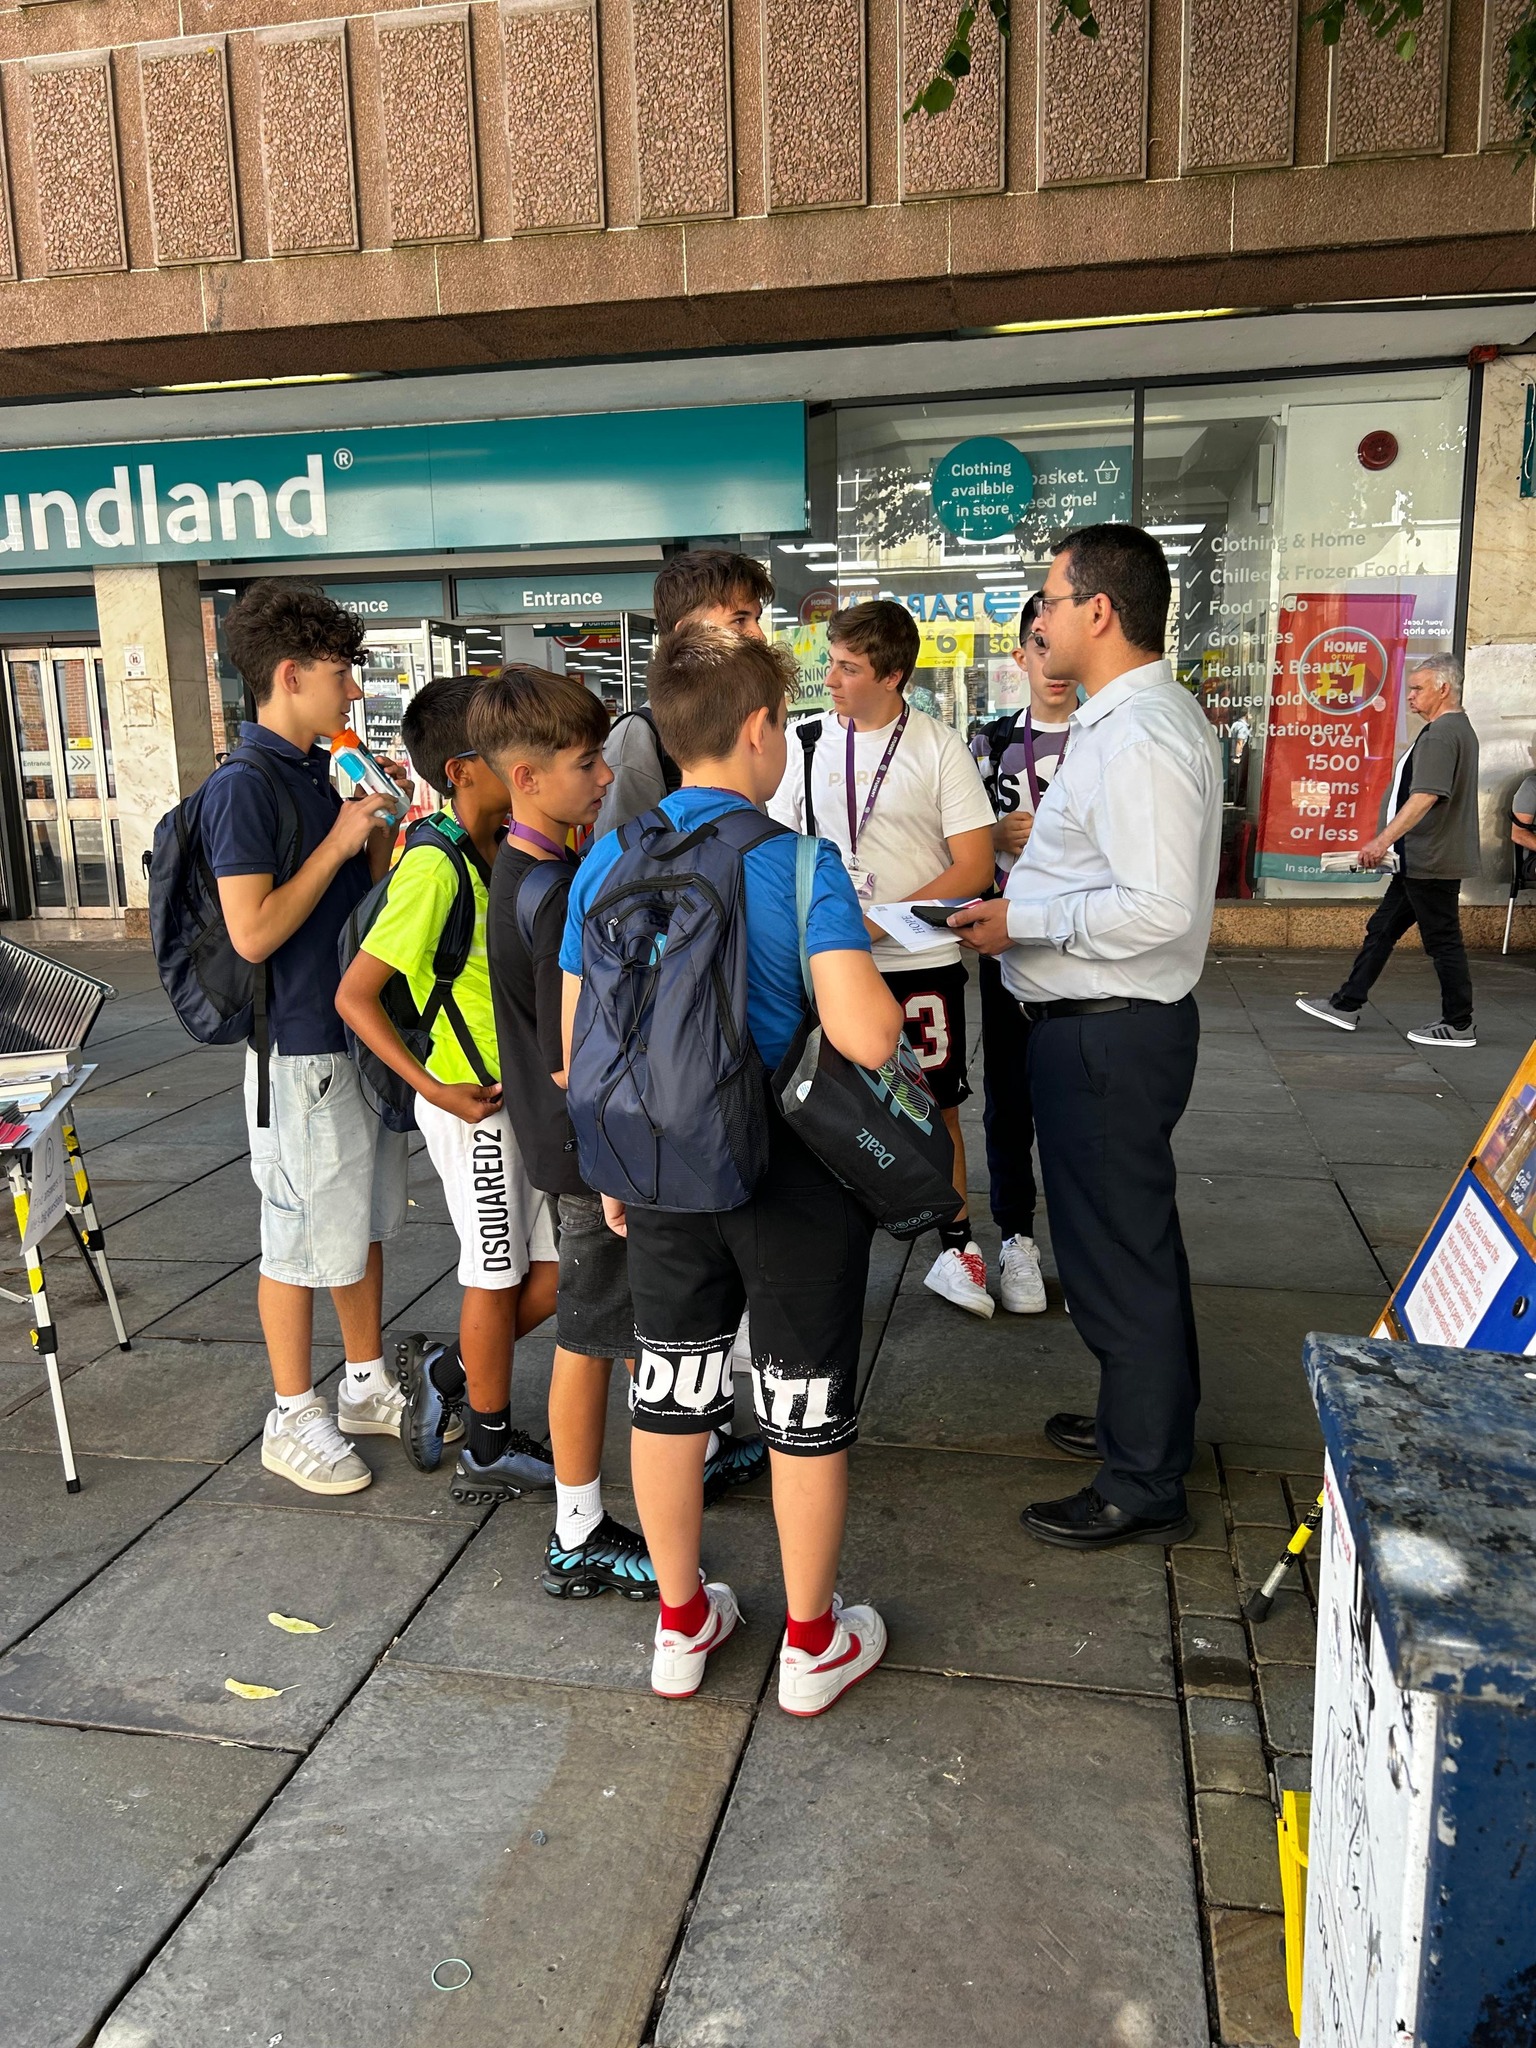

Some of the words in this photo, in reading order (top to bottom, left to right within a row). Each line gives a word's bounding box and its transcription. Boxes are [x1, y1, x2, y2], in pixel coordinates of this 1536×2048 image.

[951, 462, 1012, 477] Clothing
[951, 482, 1015, 497] available
[1028, 494, 1056, 510] eed
[1060, 491, 1098, 507] one!
[956, 504, 969, 517] in
[973, 504, 1010, 516] store
[1211, 535, 1288, 553] Clothing
[1292, 533, 1306, 548] &
[1311, 532, 1366, 548] Home
[1277, 566, 1290, 581] &
[1295, 564, 1358, 580] Frozen
[1364, 561, 1410, 577] Food
[334, 599, 389, 613] trance
[522, 590, 603, 607] Entrance
[1209, 599, 1252, 615] Food
[1256, 599, 1278, 612] To
[1284, 596, 1309, 612] Go
[1208, 631, 1294, 647] Groceries
[1323, 640, 1368, 653] HOME
[1207, 662, 1267, 677] Health
[1271, 660, 1284, 675] &
[1289, 659, 1353, 677] Beauty
[1316, 662, 1366, 698] £1
[1206, 690, 1302, 708] Household
[1309, 690, 1321, 705] &
[1326, 689, 1356, 704] Pet
[1258, 721, 1353, 738] Stationery
[1310, 731, 1364, 748] Over
[1305, 753, 1360, 771] 1500
[828, 770, 891, 787] PRS
[1299, 776, 1360, 795] items
[1298, 801, 1330, 817] for
[1334, 802, 1357, 818] £1
[1290, 826, 1314, 840] or
[1318, 824, 1359, 841] less
[1285, 863, 1295, 872] In
[1298, 864, 1324, 874] stor
[901, 914, 926, 935] HOPE
[855, 1127, 896, 1170] Dealz
[472, 1128, 512, 1272] DSQUARED2
